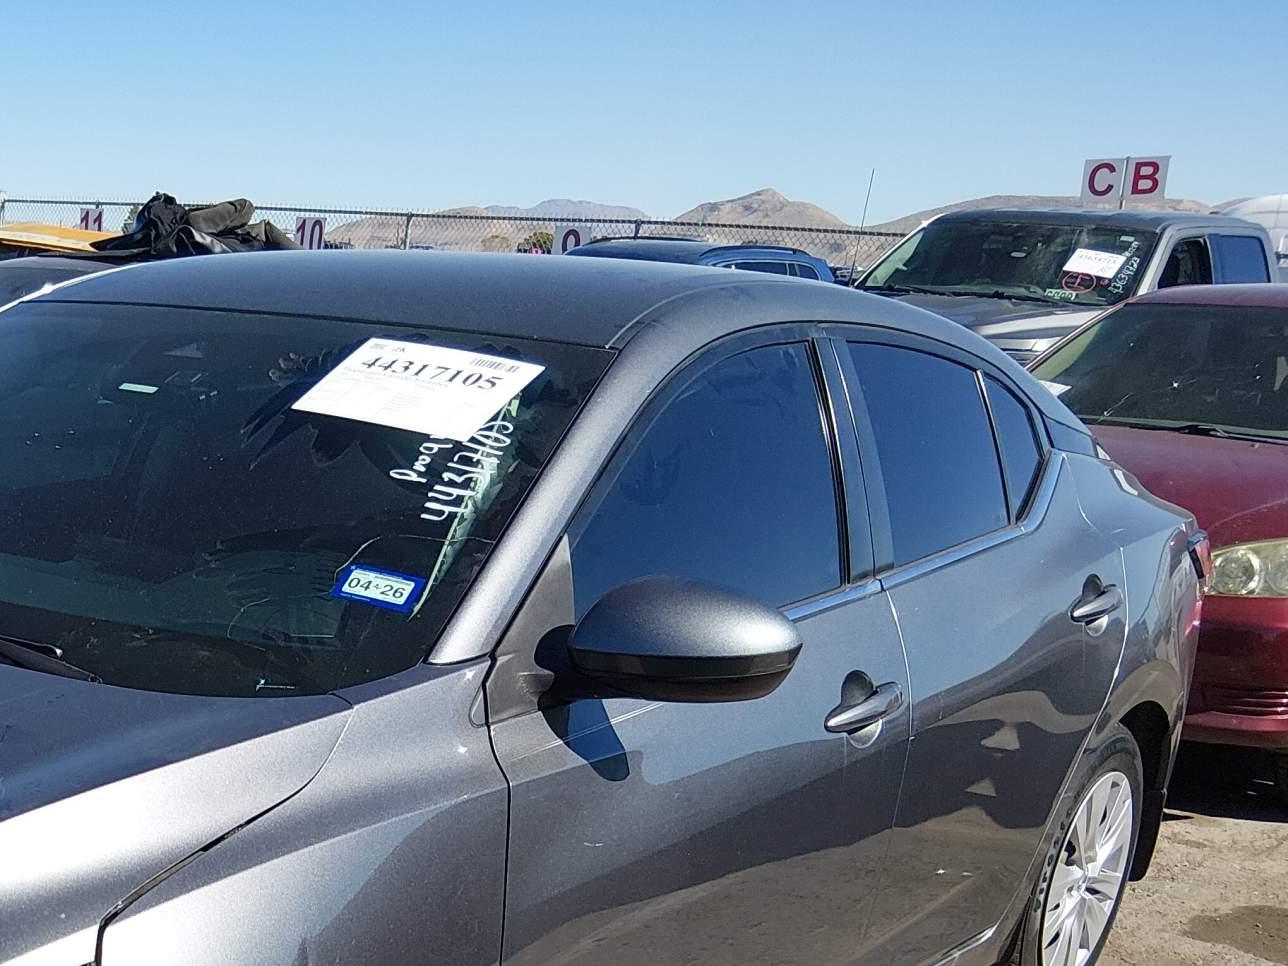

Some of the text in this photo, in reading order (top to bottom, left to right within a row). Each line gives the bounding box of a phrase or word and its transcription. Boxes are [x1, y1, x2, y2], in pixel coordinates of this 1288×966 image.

[1088, 162, 1116, 196] C
[1131, 161, 1160, 195] B
[81, 209, 102, 232] 11
[297, 219, 323, 250] 10
[361, 356, 504, 390] 44317105
[347, 577, 373, 592] 04
[379, 584, 406, 599] 26
